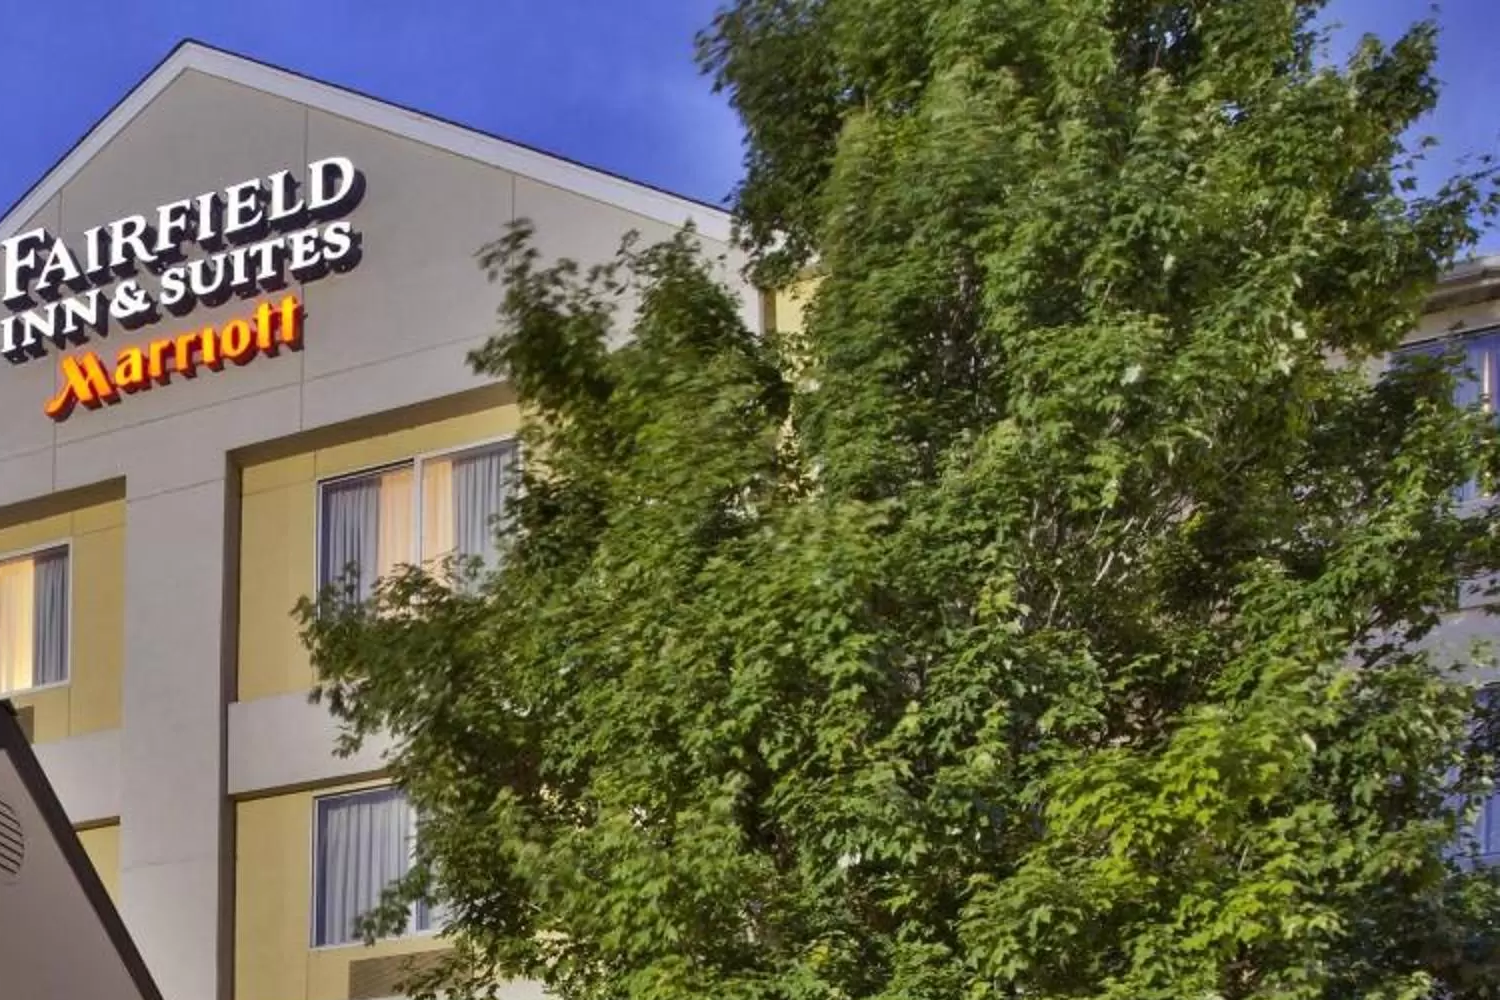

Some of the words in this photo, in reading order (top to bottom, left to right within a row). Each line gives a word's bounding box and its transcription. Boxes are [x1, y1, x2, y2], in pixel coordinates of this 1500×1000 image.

[0, 288, 101, 354] INN
[108, 279, 152, 321] &
[159, 221, 353, 306] SUITES
[1, 156, 357, 302] FAIRFIELD
[44, 295, 301, 419] Marriott
